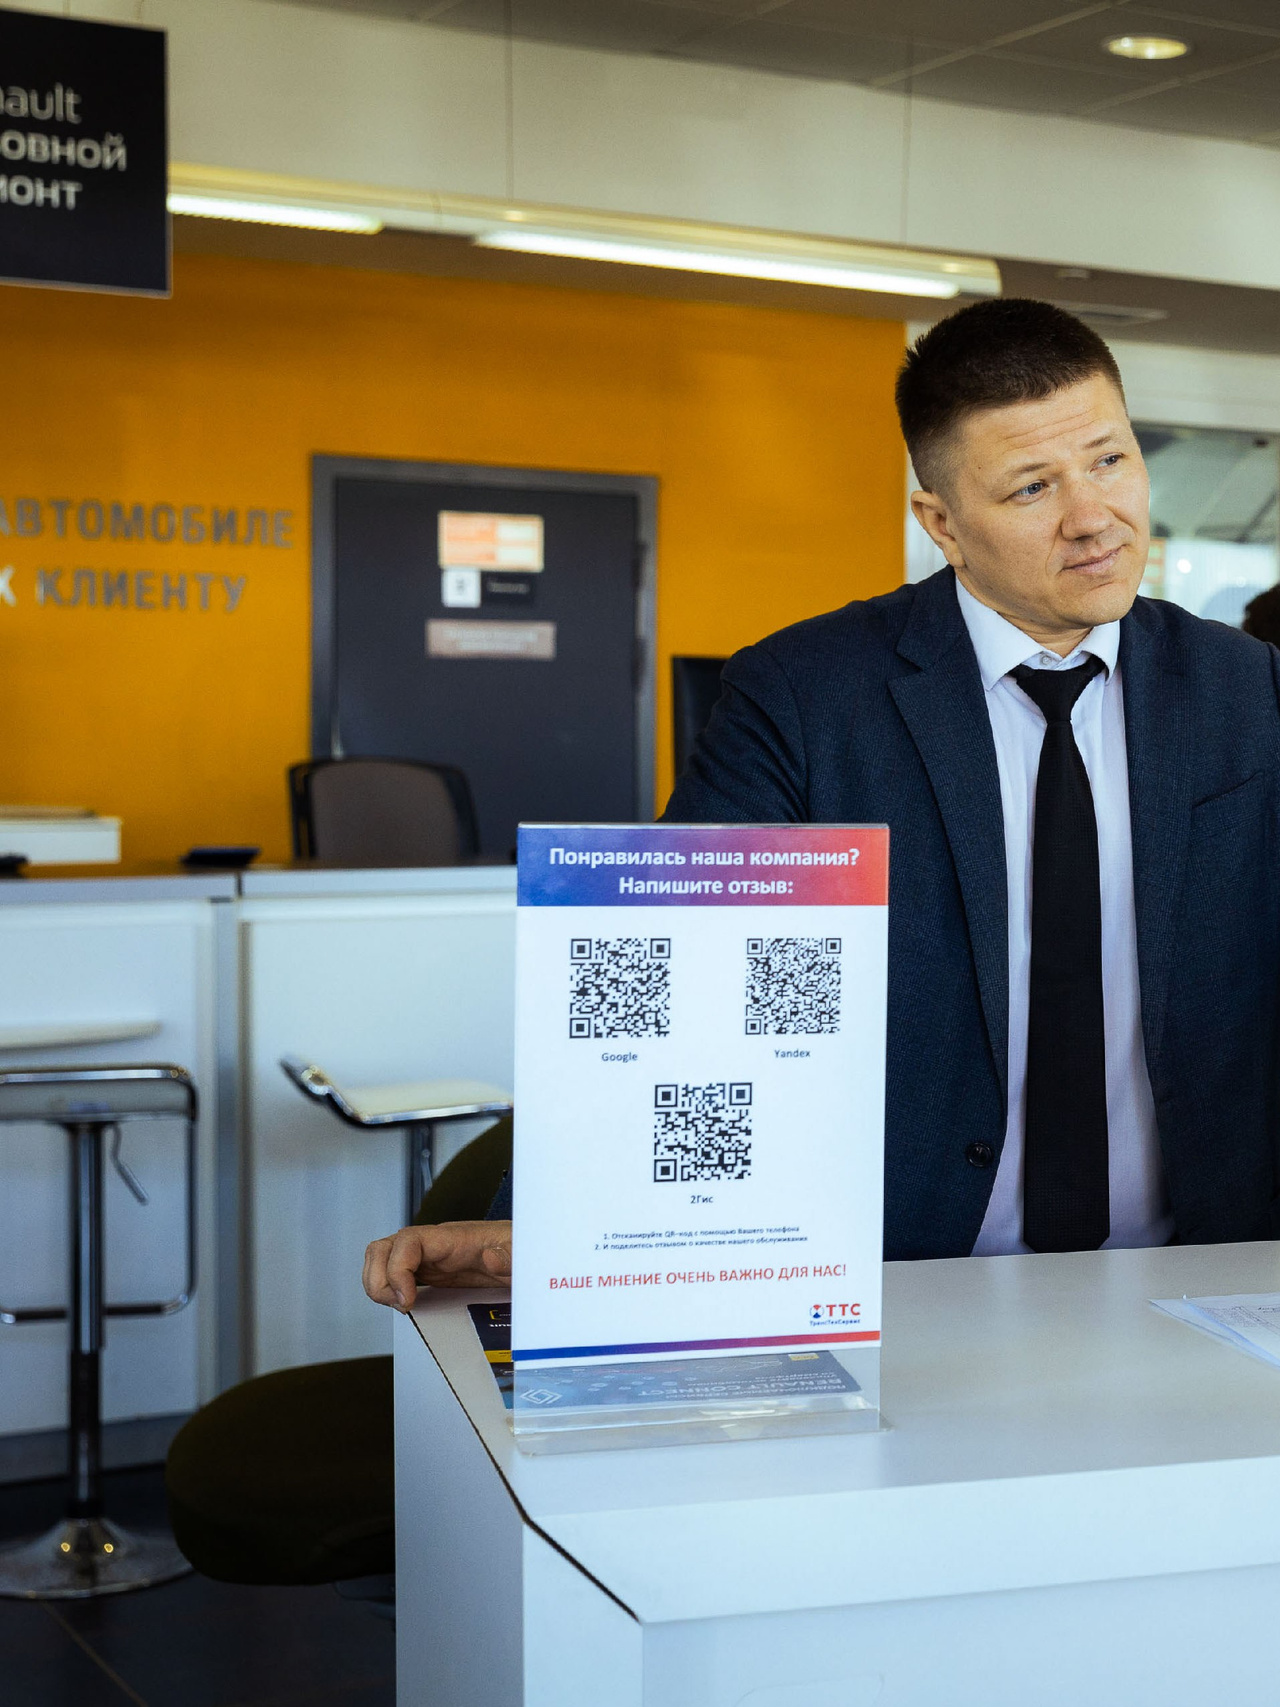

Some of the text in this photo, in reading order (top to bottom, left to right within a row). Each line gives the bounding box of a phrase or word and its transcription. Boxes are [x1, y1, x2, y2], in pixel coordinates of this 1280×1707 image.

[37, 567, 247, 613] КЛИЕНТУ
[550, 848, 860, 868] Понравилась наша компания?
[619, 877, 794, 895] Напишите отзыв:
[601, 1052, 638, 1063] Google
[774, 1049, 811, 1059] Yandex
[690, 1195, 714, 1205] 2Гис
[611, 1231, 663, 1240] Отсканируйте
[766, 1226, 799, 1234] телефона
[756, 1236, 808, 1245] обслуживания
[550, 1264, 847, 1290] ВАШЕ МНЕНИЕ ОЧЕНЬ ВАЖНО ДЛЯ НАС!
[826, 1303, 861, 1317] ТТС
